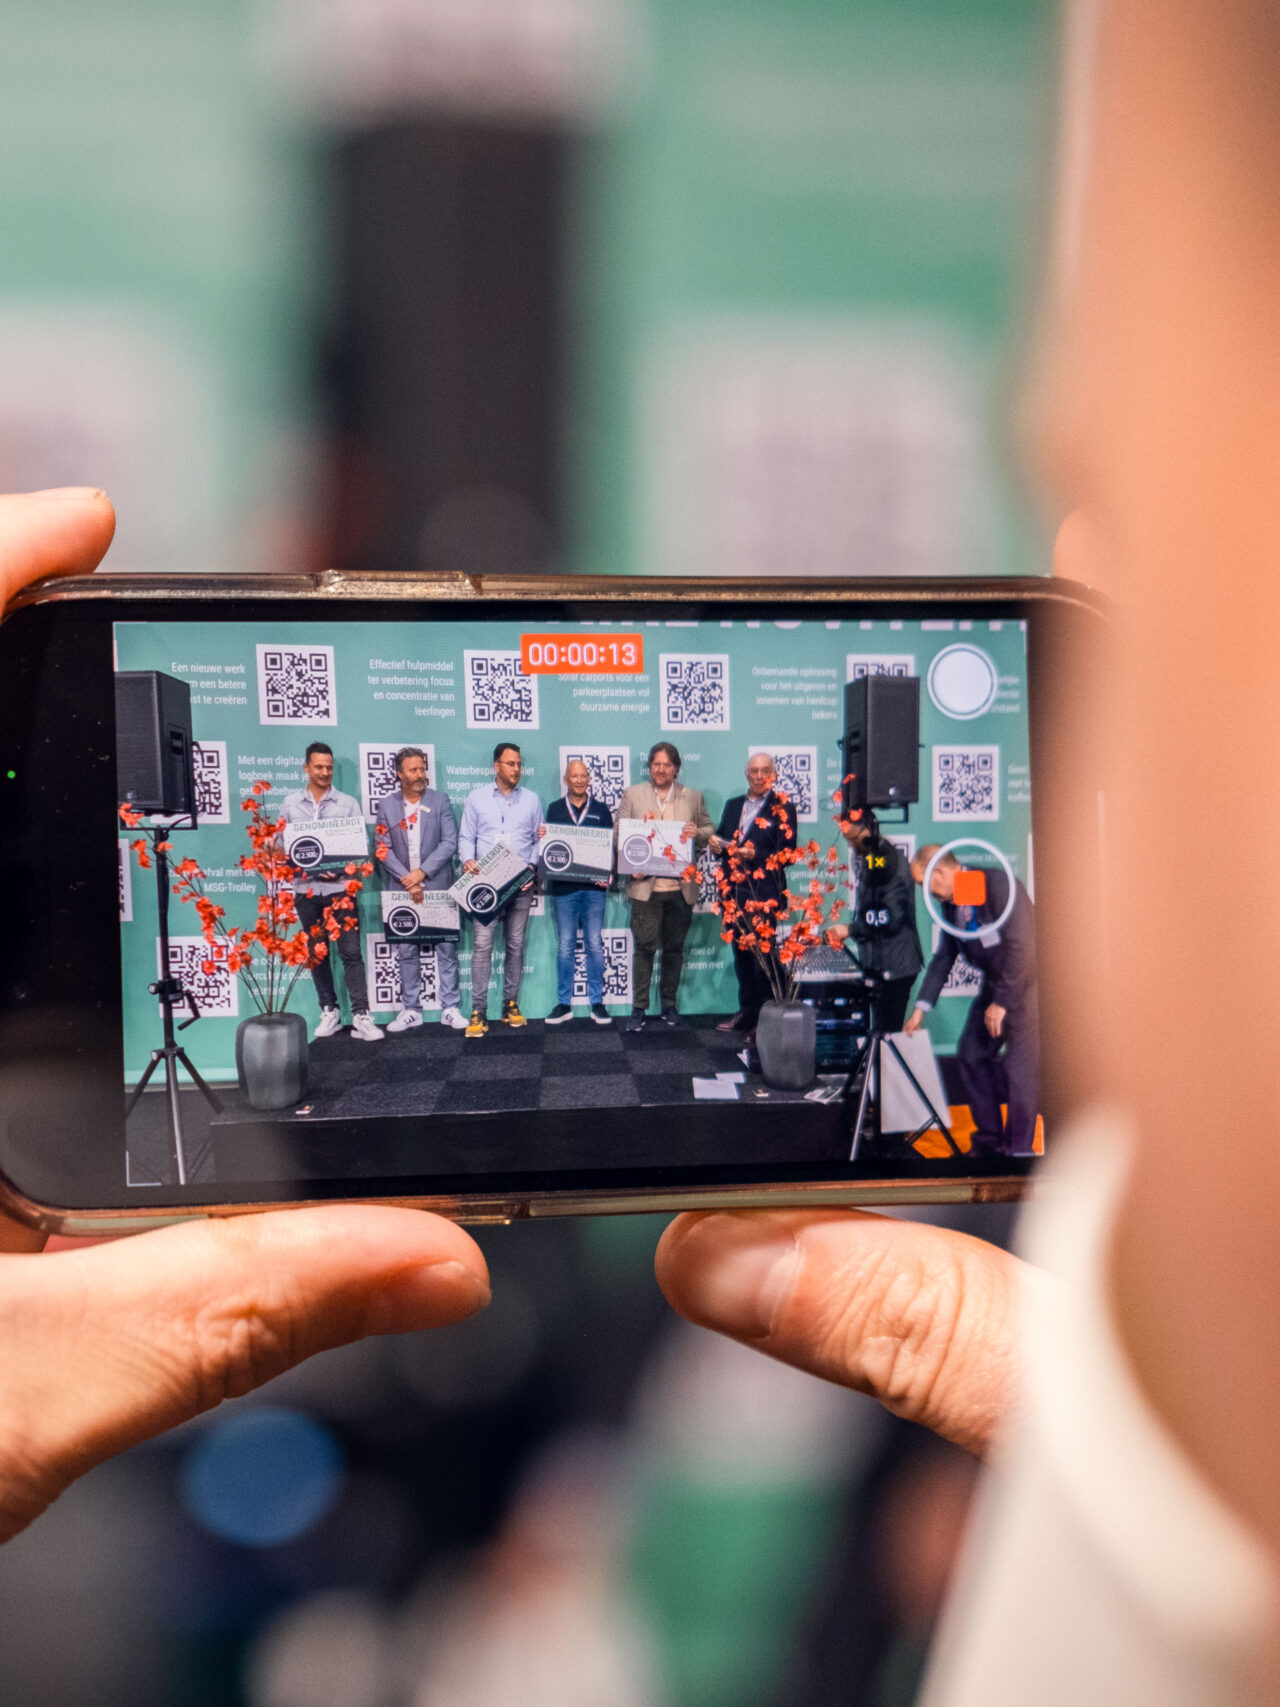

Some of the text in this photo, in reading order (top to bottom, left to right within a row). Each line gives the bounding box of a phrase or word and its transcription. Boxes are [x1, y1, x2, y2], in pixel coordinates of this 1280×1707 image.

[528, 642, 637, 666] 00:00:13
[171, 662, 246, 674] Een nieuwe werk
[369, 659, 454, 672] Effectief hulpmiddel
[368, 676, 454, 688] ter verbetering focus
[616, 674, 632, 682] voor
[634, 674, 648, 682] een
[200, 680, 216, 688] een
[218, 679, 246, 689] betere
[203, 696, 212, 704] te
[214, 695, 247, 704] creëren
[373, 692, 455, 702] en concentratie van
[414, 706, 456, 718] leerlingen
[238, 756, 255, 765] Met
[257, 757, 273, 765] een
[238, 771, 273, 782] logboek
[276, 772, 299, 780] maak
[446, 782, 470, 791] tegen
[204, 882, 256, 894] MSG-Trolley
[865, 910, 888, 928] 0,5
[708, 961, 724, 970] met
